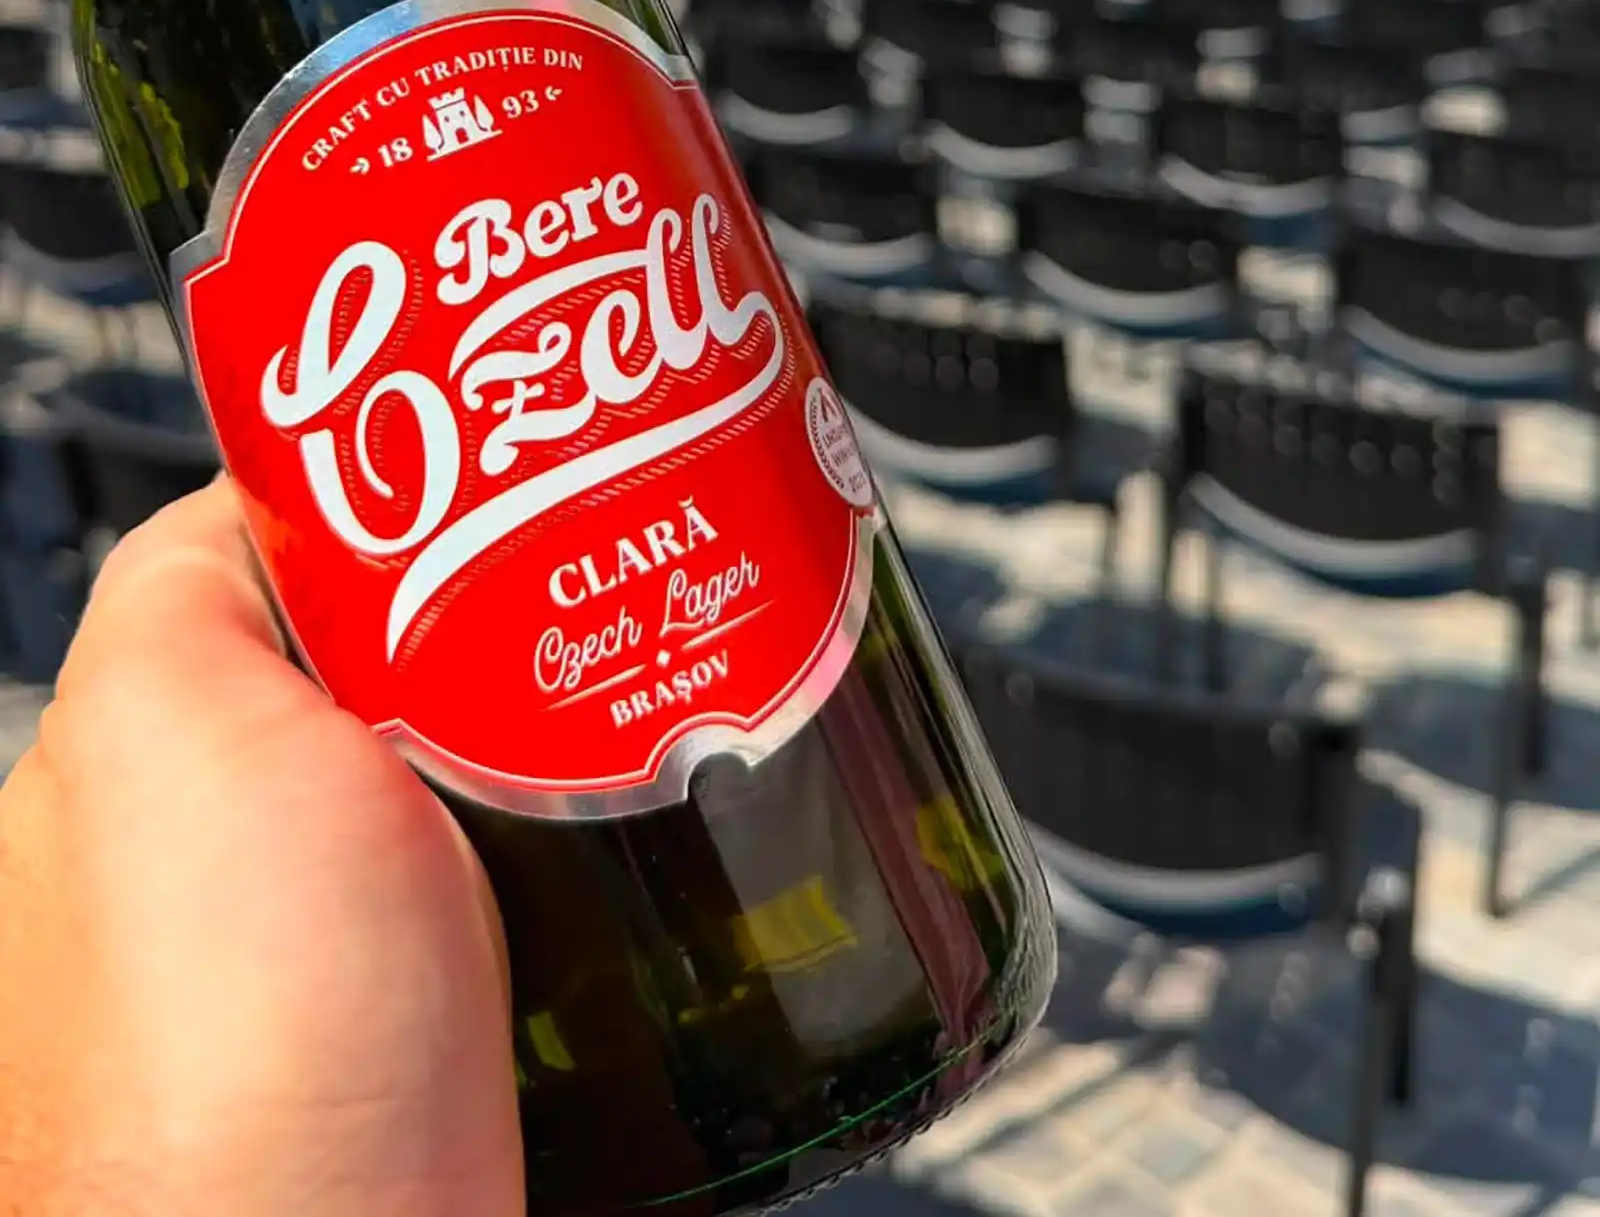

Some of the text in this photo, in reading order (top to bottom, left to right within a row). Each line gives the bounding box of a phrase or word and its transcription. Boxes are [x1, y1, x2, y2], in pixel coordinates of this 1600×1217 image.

[301, 47, 584, 171] CRAFT CU TRADIȚIE DIN
[377, 88, 540, 168] 18 93
[434, 172, 644, 305] Bere
[548, 494, 720, 609] CLARĂ
[533, 549, 761, 694] Czech Lager
[609, 648, 729, 729] BRAȘOV
